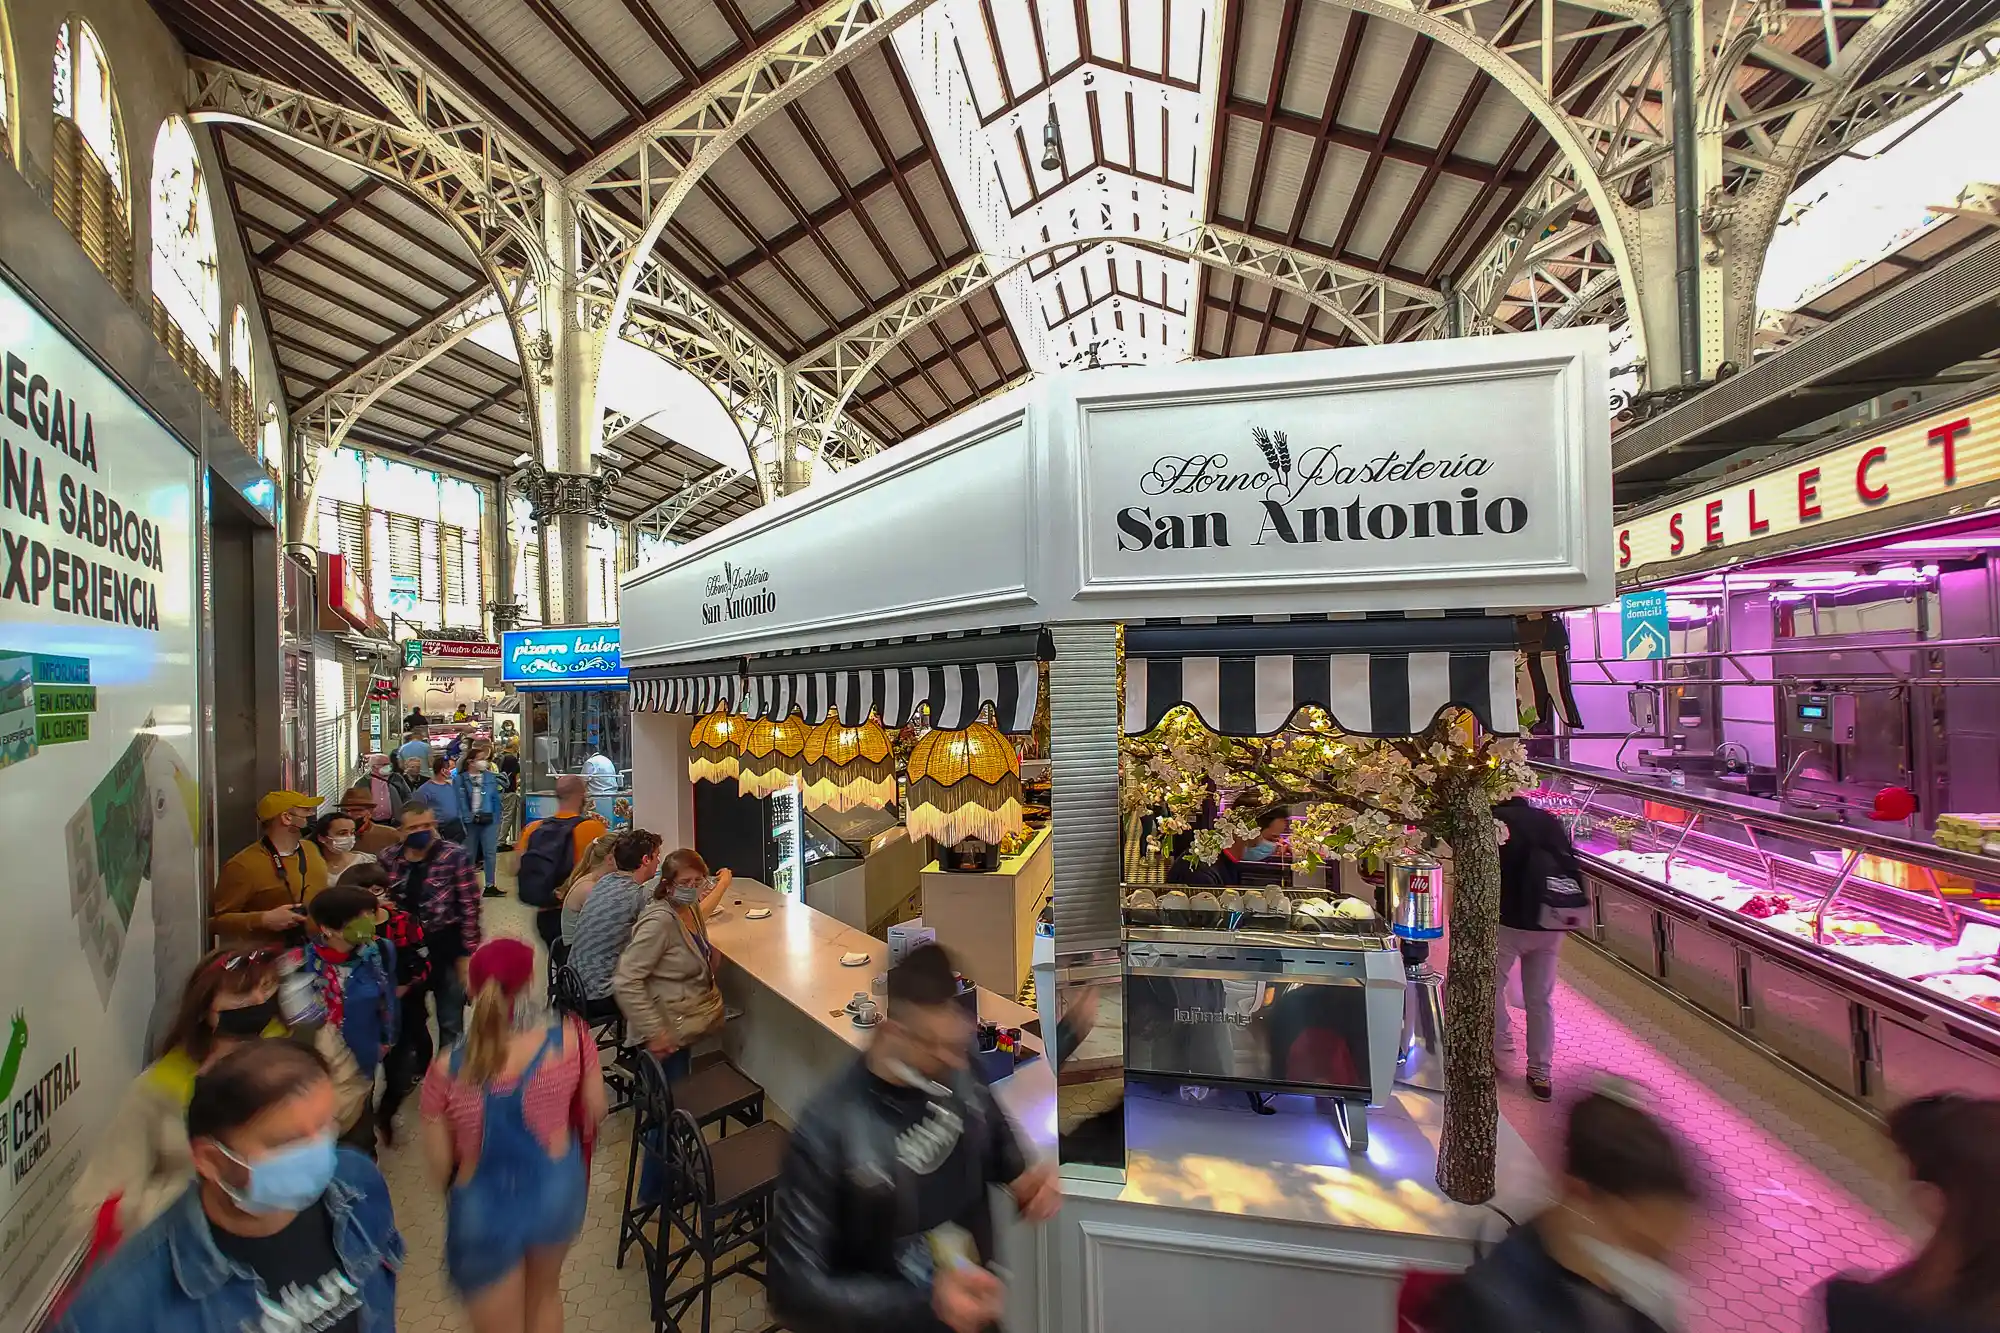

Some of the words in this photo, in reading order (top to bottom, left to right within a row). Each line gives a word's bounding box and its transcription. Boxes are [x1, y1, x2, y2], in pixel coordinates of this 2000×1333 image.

[0, 350, 98, 473] EGALA
[1139, 452, 1272, 496] Horno
[1282, 444, 1495, 506] Pastelería
[1669, 417, 1972, 554] SELECT
[0, 436, 50, 526] NA
[58, 473, 164, 573] SABROSA
[1116, 505, 1231, 552] San
[1250, 487, 1528, 547] Antonio
[0, 527, 160, 632] XPERIENCIA
[1626, 596, 1654, 609] Servei
[1655, 597, 1662, 606] a
[701, 602, 722, 626] San
[724, 587, 777, 621] Antonio
[1626, 605, 1662, 619] domicili
[512, 637, 568, 663] pizarro
[40, 693, 53, 713] EN
[40, 721, 51, 741] AL
[1410, 877, 1429, 892] illy
[13, 1046, 81, 1153] CENTRAL
